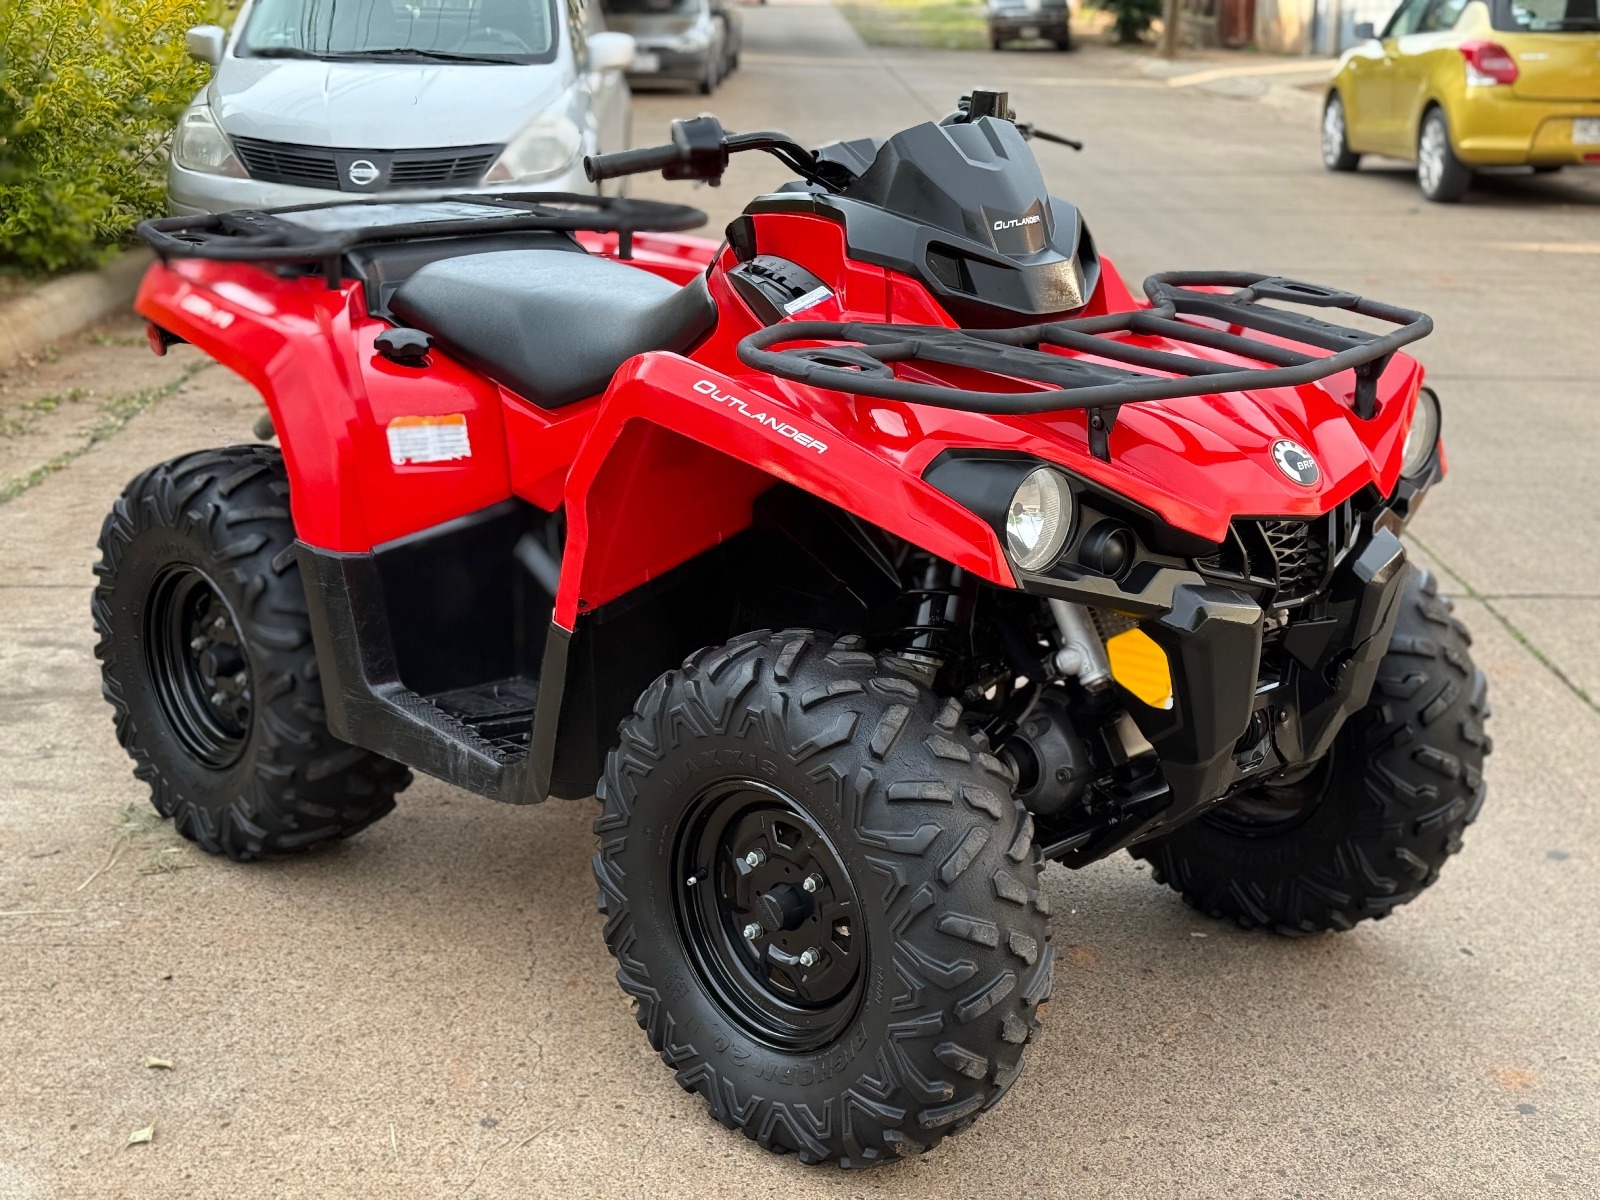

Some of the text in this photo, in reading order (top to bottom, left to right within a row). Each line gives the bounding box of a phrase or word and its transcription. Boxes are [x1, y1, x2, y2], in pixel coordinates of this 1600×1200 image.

[993, 215, 1040, 231] OUTLANDER
[692, 380, 829, 454] OUTLANDER
[1296, 459, 1315, 471] BRP
